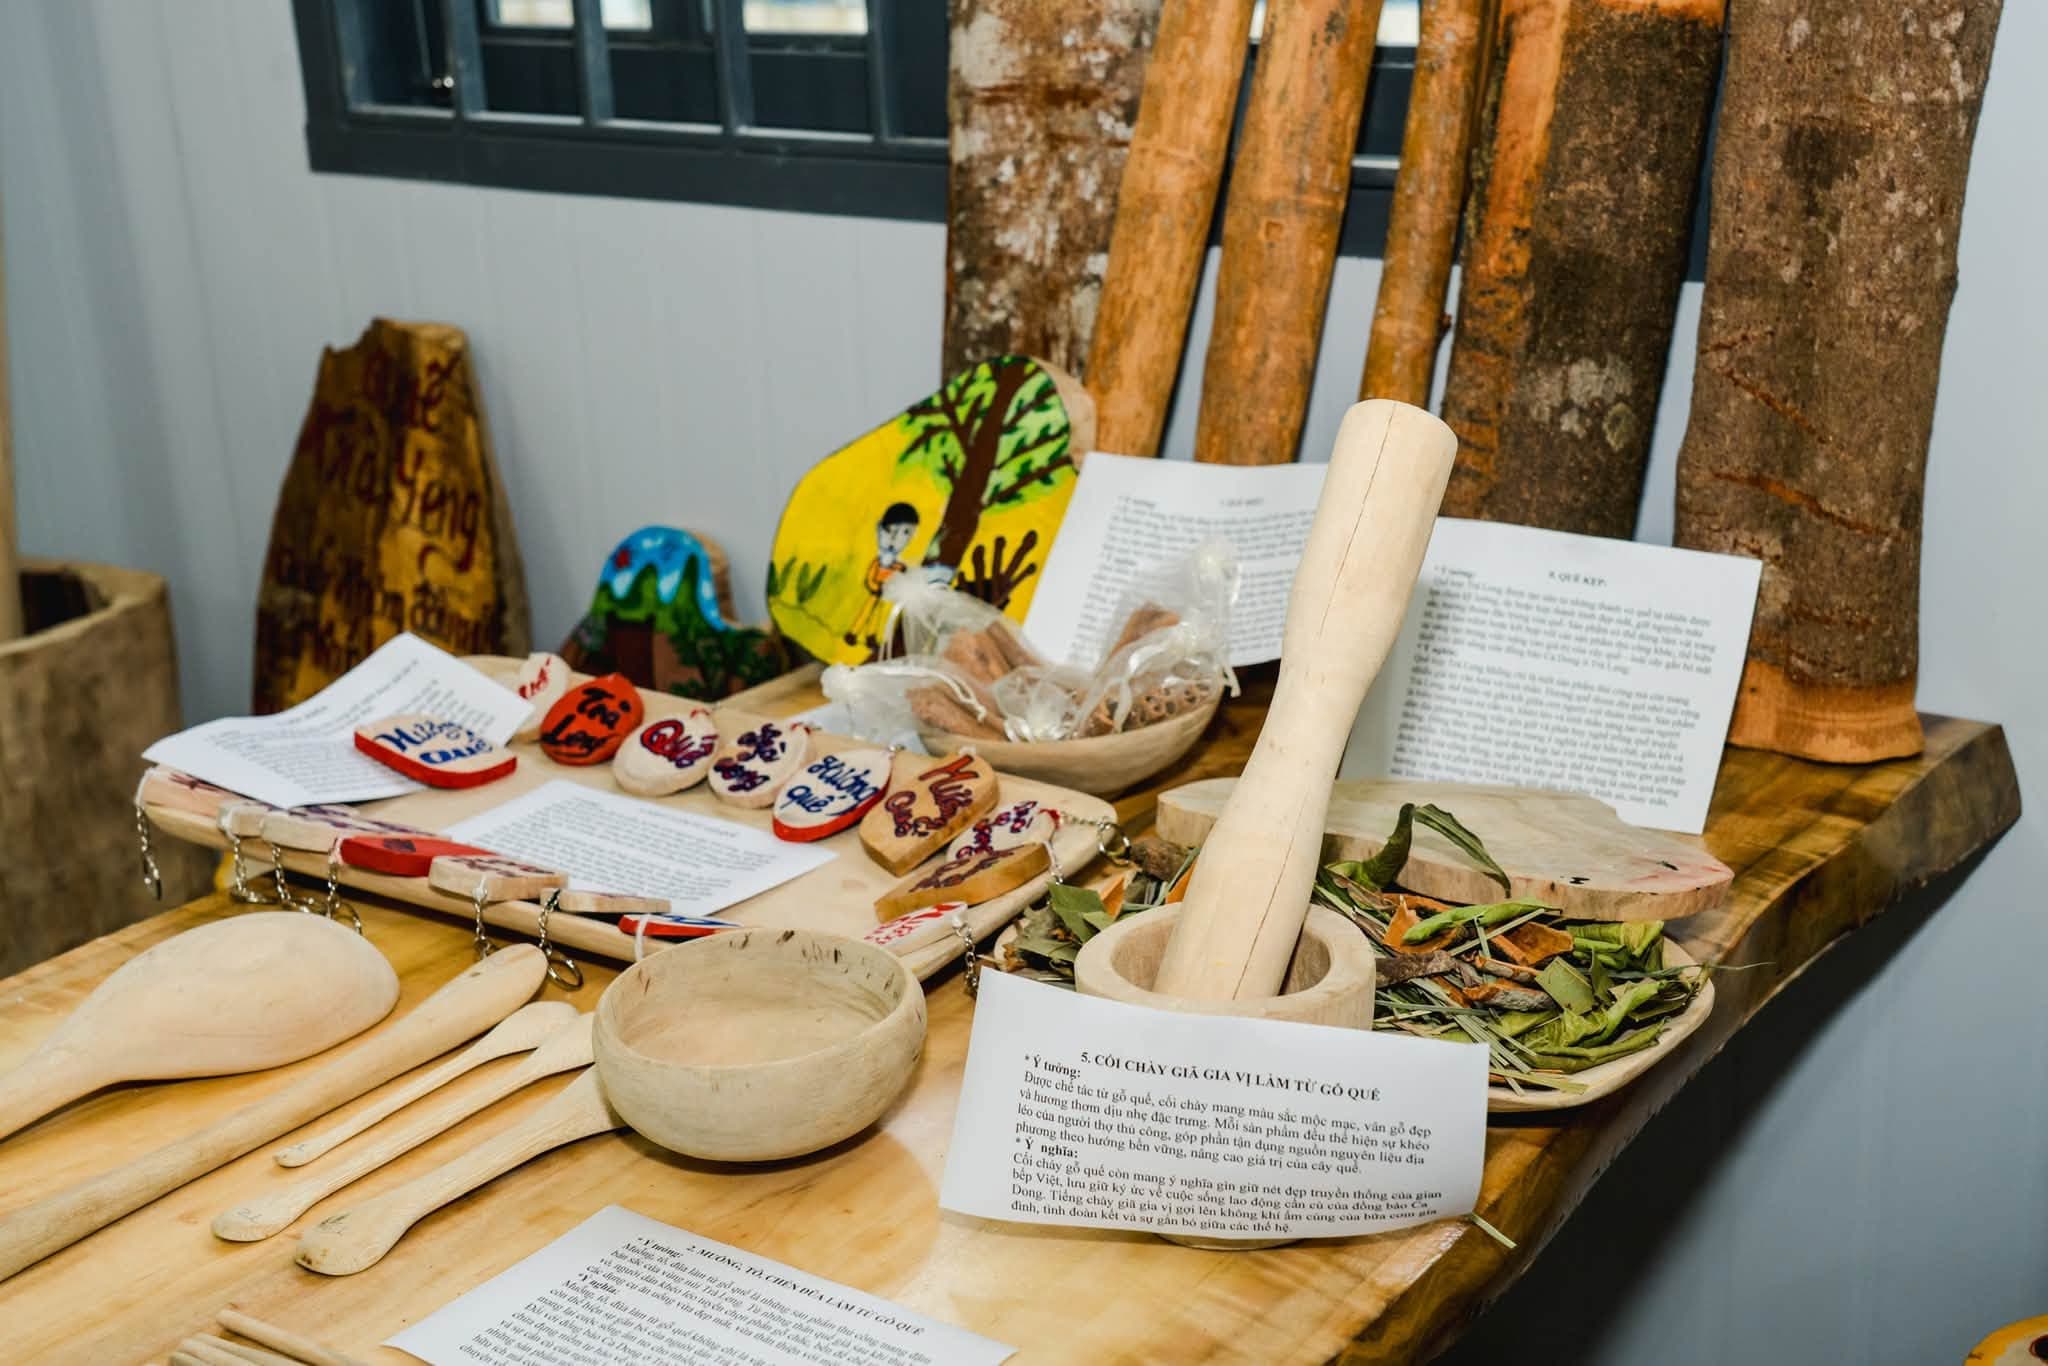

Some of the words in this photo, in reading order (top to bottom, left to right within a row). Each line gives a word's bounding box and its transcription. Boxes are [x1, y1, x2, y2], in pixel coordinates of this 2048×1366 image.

[1032, 1055, 1042, 1069] Ý
[1080, 1051, 1091, 1064] 5.
[1172, 1066, 1200, 1079] GIÃ
[1203, 1069, 1230, 1081] GIA
[1236, 1072, 1250, 1087] VỊ
[1020, 1089, 1032, 1100] và
[1034, 1090, 1068, 1111] hương
[1071, 1099, 1100, 1113] thơm
[1104, 1103, 1122, 1119] dịu
[1126, 1108, 1148, 1123] nhẹ
[1175, 1115, 1210, 1130] trưng.
[1214, 1116, 1238, 1130] Mỗi
[1266, 1125, 1300, 1139] phẩm
[1304, 1128, 1326, 1142] đều
[1329, 1131, 1348, 1144] thể
[1352, 1134, 1378, 1149] hiện
[1382, 1140, 1396, 1152] sự
[1400, 1138, 1430, 1151] khéo
[1024, 1071, 1052, 1089] Được
[1054, 1079, 1074, 1093] chế
[1077, 1085, 1094, 1097] tác
[1096, 1089, 1108, 1100] từ
[1158, 1093, 1176, 1107] cối
[1212, 1105, 1246, 1118] mang
[1278, 1109, 1297, 1123] sắc
[1301, 1114, 1326, 1128] mộc
[1408, 1123, 1432, 1140] đẹp
[1016, 1122, 1056, 1142] phương
[1060, 1130, 1084, 1143] theo
[1088, 1133, 1126, 1152] hướng
[1153, 1144, 1187, 1160] vững,
[1223, 1153, 1244, 1163] cao
[1247, 1154, 1266, 1167] giá
[1269, 1157, 1282, 1171] trị
[1286, 1158, 1308, 1170] của
[1311, 1160, 1332, 1175] cây
[1018, 1103, 1033, 1117] léo
[1036, 1109, 1055, 1122] của
[1058, 1115, 1090, 1128] người
[1094, 1119, 1112, 1134] thợ
[1116, 1122, 1136, 1135] thủ
[1139, 1126, 1172, 1142] công,
[1174, 1132, 1198, 1146] góp
[1201, 1132, 1230, 1147] phần
[1234, 1136, 1250, 1150] tận
[1254, 1138, 1285, 1156] dụng
[1288, 1143, 1326, 1158] nguồn
[1330, 1149, 1376, 1163] nguyên
[1380, 1150, 1402, 1165] liệu
[1406, 1152, 1424, 1167] địa
[1026, 1137, 1034, 1151] Ý
[1040, 1144, 1078, 1159] nghĩa:
[1012, 1166, 1032, 1184] bếp
[1036, 1171, 1063, 1188] Việt,
[1066, 1176, 1086, 1189] lưu
[1088, 1180, 1109, 1193] giữ
[1112, 1181, 1126, 1196] ký
[1130, 1184, 1144, 1196] ức
[1149, 1184, 1162, 1197] về
[1166, 1189, 1194, 1202] cuộc
[1198, 1190, 1225, 1207] sống
[1229, 1194, 1247, 1205] lao
[1250, 1195, 1281, 1210] động
[1327, 1200, 1348, 1210] của
[1013, 1151, 1033, 1166] Cối
[1108, 1168, 1130, 1180] còn
[1133, 1173, 1166, 1186] mang
[1170, 1173, 1176, 1187] ý
[1180, 1176, 1213, 1189] nghĩa
[1239, 1183, 1260, 1195] giữ
[1262, 1184, 1280, 1194] nét
[1284, 1185, 1307, 1199] đẹp
[1352, 1188, 1388, 1202] thống
[1391, 1191, 1412, 1199] của
[1416, 1190, 1442, 1201] gian
[1012, 1183, 1046, 1201] Dong.
[1050, 1189, 1083, 1207] Tiếng
[1118, 1198, 1136, 1211] giã
[1162, 1202, 1172, 1215] vị
[1176, 1203, 1195, 1216] gợi
[1200, 1204, 1216, 1216] lên
[1220, 1206, 1257, 1222] không
[1262, 1209, 1280, 1220] khí
[1338, 1212, 1360, 1221] của
[1100, 1206, 1118, 1220] kết
[1122, 1211, 1136, 1222] và
[1140, 1215, 1153, 1226] sự
[1200, 1218, 1226, 1231] giữa
[1230, 1220, 1248, 1231] các
[1252, 1219, 1272, 1231] thế
